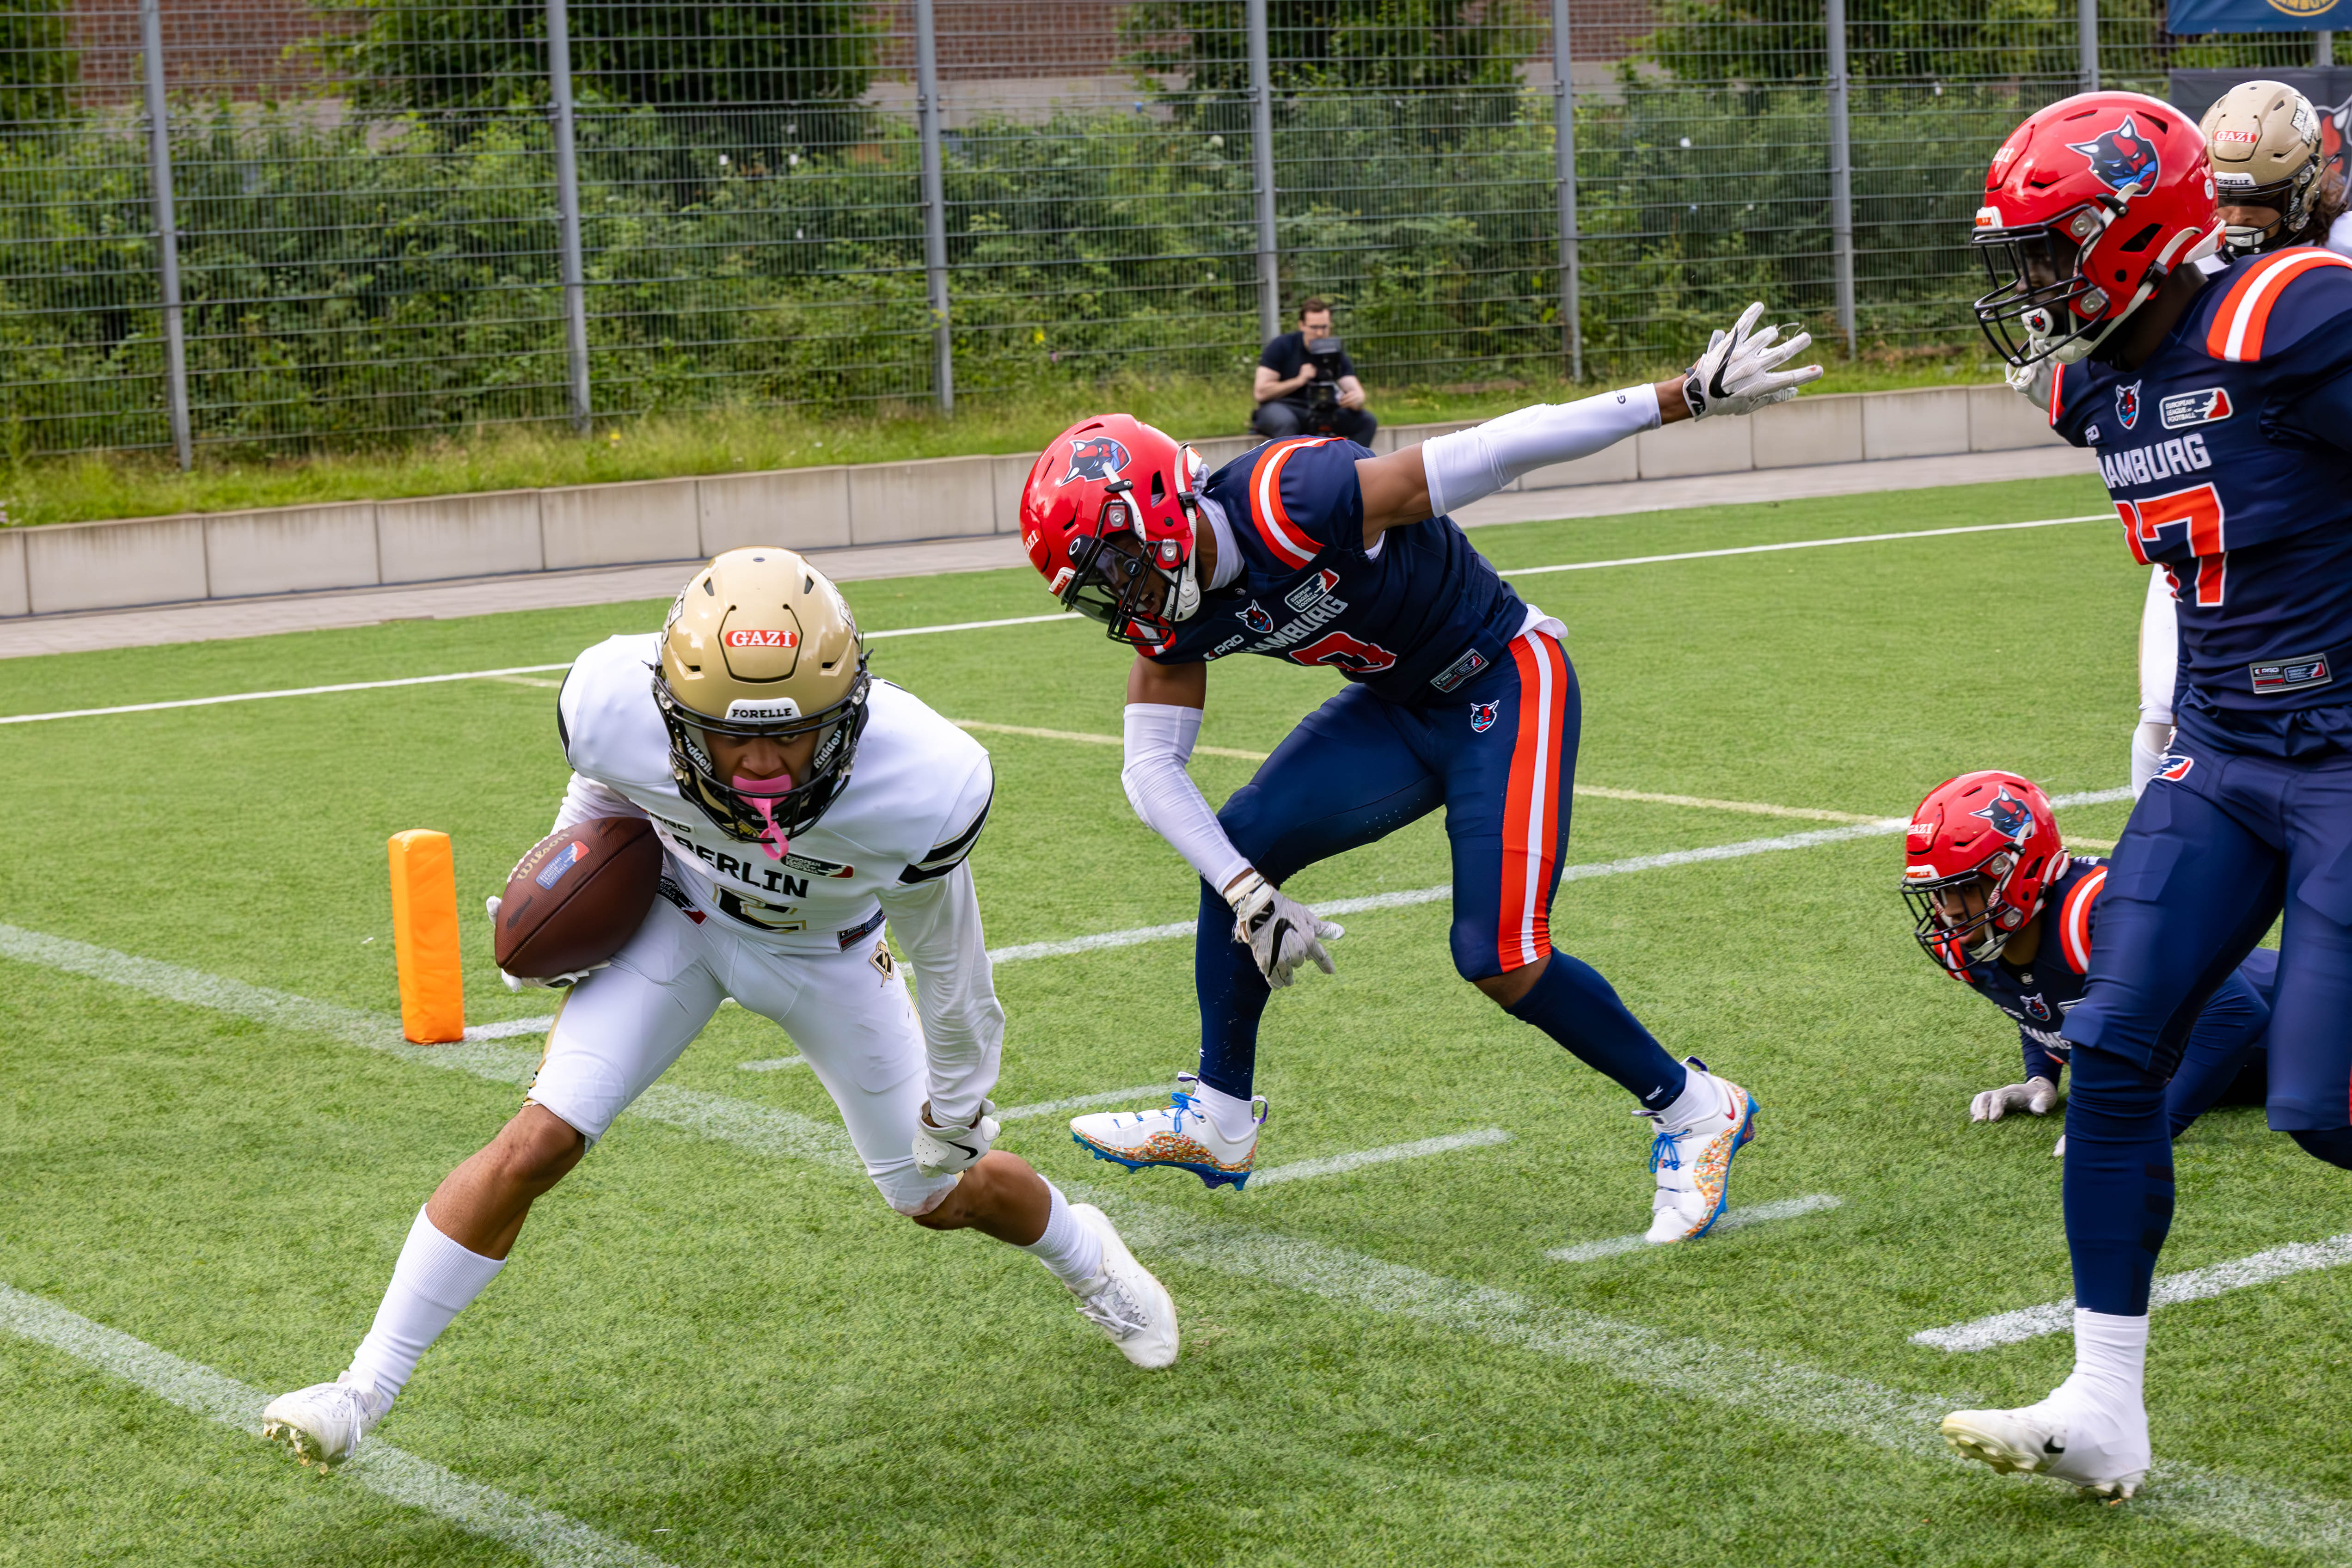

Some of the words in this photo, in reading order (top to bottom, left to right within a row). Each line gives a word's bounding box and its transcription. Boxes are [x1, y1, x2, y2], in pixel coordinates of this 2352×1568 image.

[2165, 398, 2196, 410] EUROPEAN
[2166, 407, 2187, 416] LEAGUE
[2167, 412, 2197, 423] FOOTBALL
[1290, 586, 1311, 602] EUROPEAN
[1294, 593, 1309, 606] LEAGUE
[1298, 593, 1319, 608] FOOTBALL
[732, 708, 792, 718] FORELLE
[813, 729, 842, 769] Riddell
[515, 833, 571, 880] Wilson
[786, 855, 821, 867] EUROPEAN
[786, 859, 810, 869] LEAGUE
[786, 862, 818, 874] FOOTBALL
